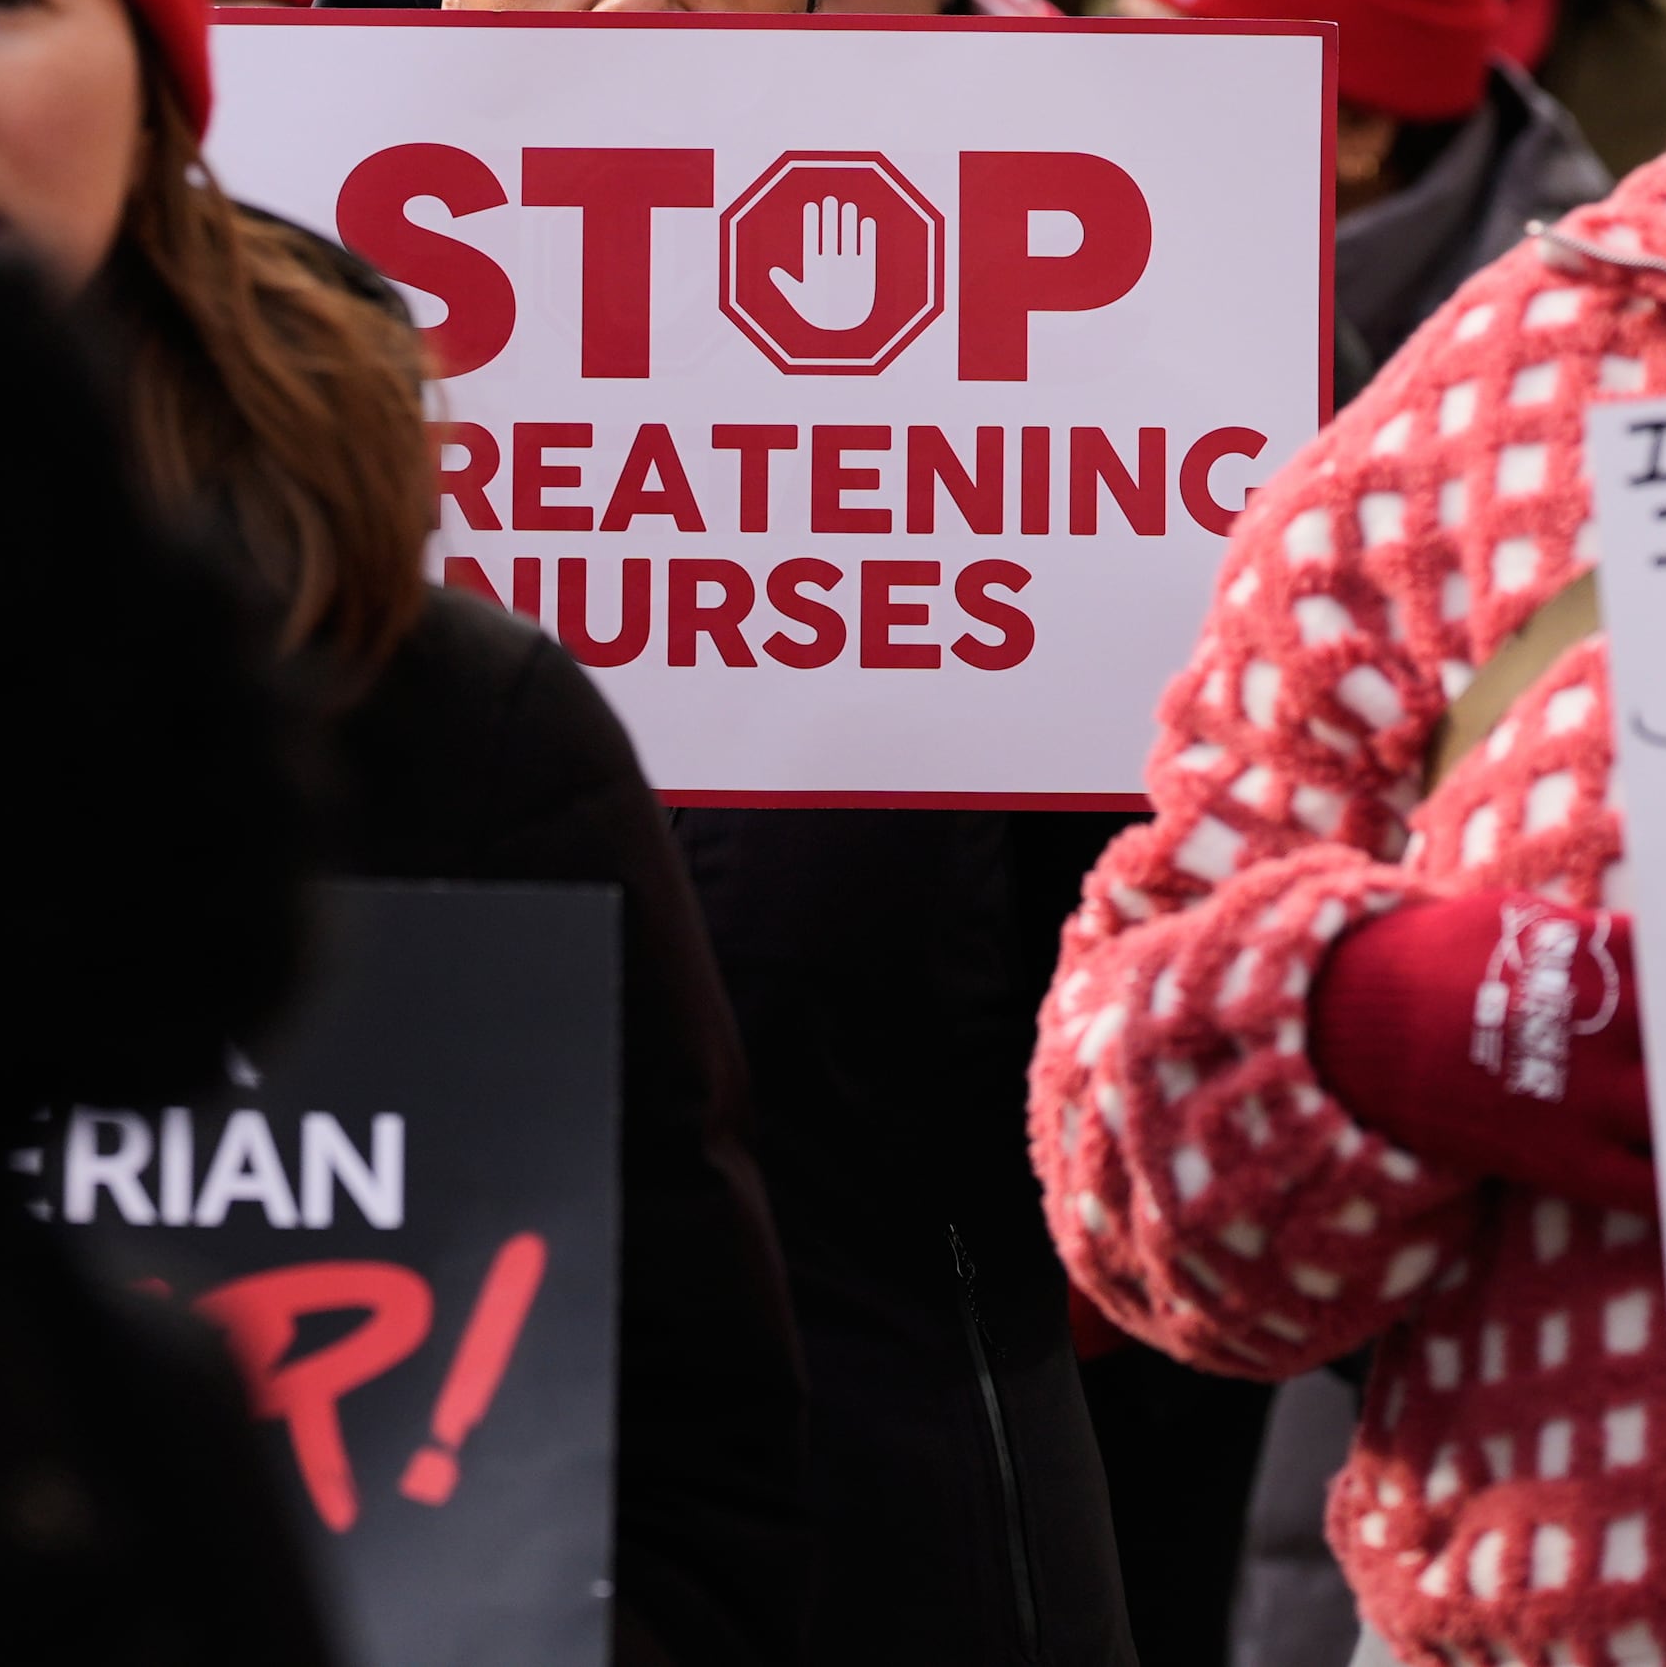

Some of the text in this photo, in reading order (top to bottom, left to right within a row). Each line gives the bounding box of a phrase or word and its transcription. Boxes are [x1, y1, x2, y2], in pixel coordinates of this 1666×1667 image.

[335, 141, 1153, 382] STOP
[423, 420, 1269, 537] REATENING
[13, 1104, 406, 1231] RIAN
